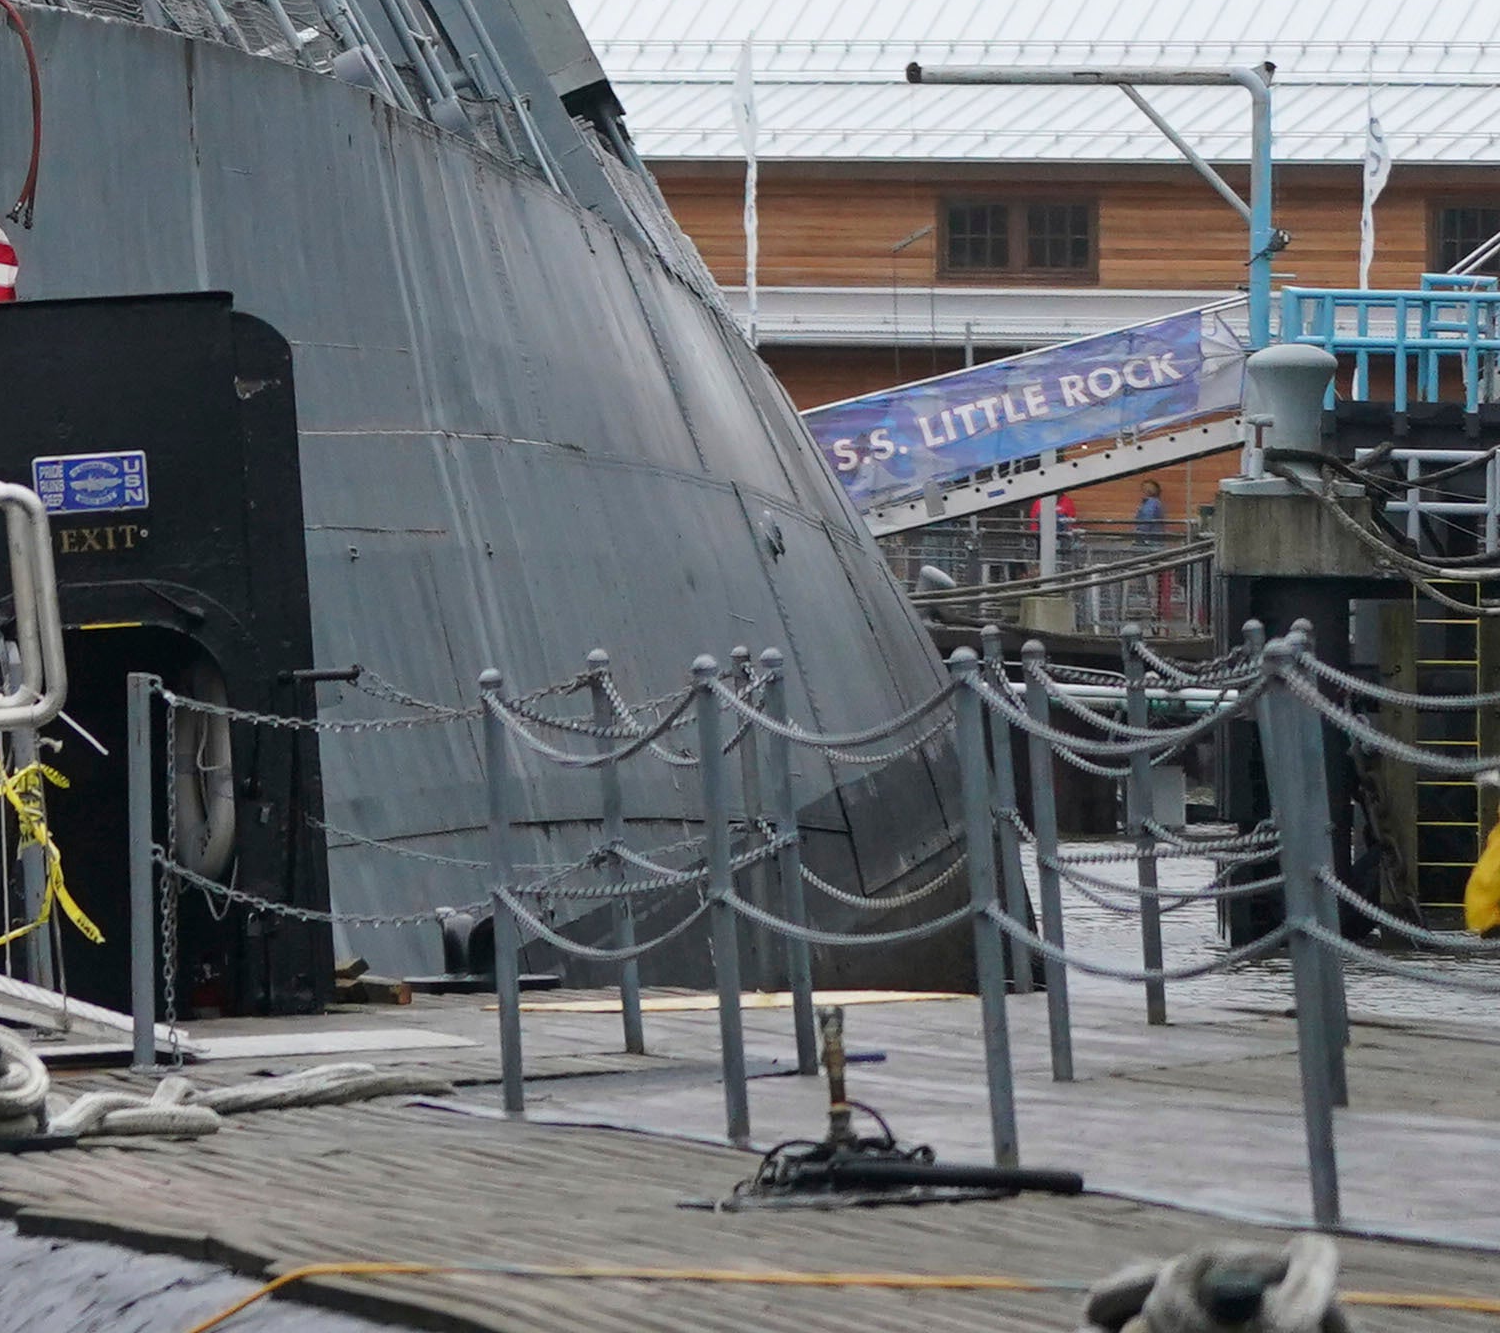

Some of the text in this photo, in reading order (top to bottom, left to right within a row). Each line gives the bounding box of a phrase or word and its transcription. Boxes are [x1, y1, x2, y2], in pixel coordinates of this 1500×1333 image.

[916, 383, 1051, 449] LITTLE
[1058, 352, 1185, 409] ROCK
[60, 524, 139, 554] EXIT
